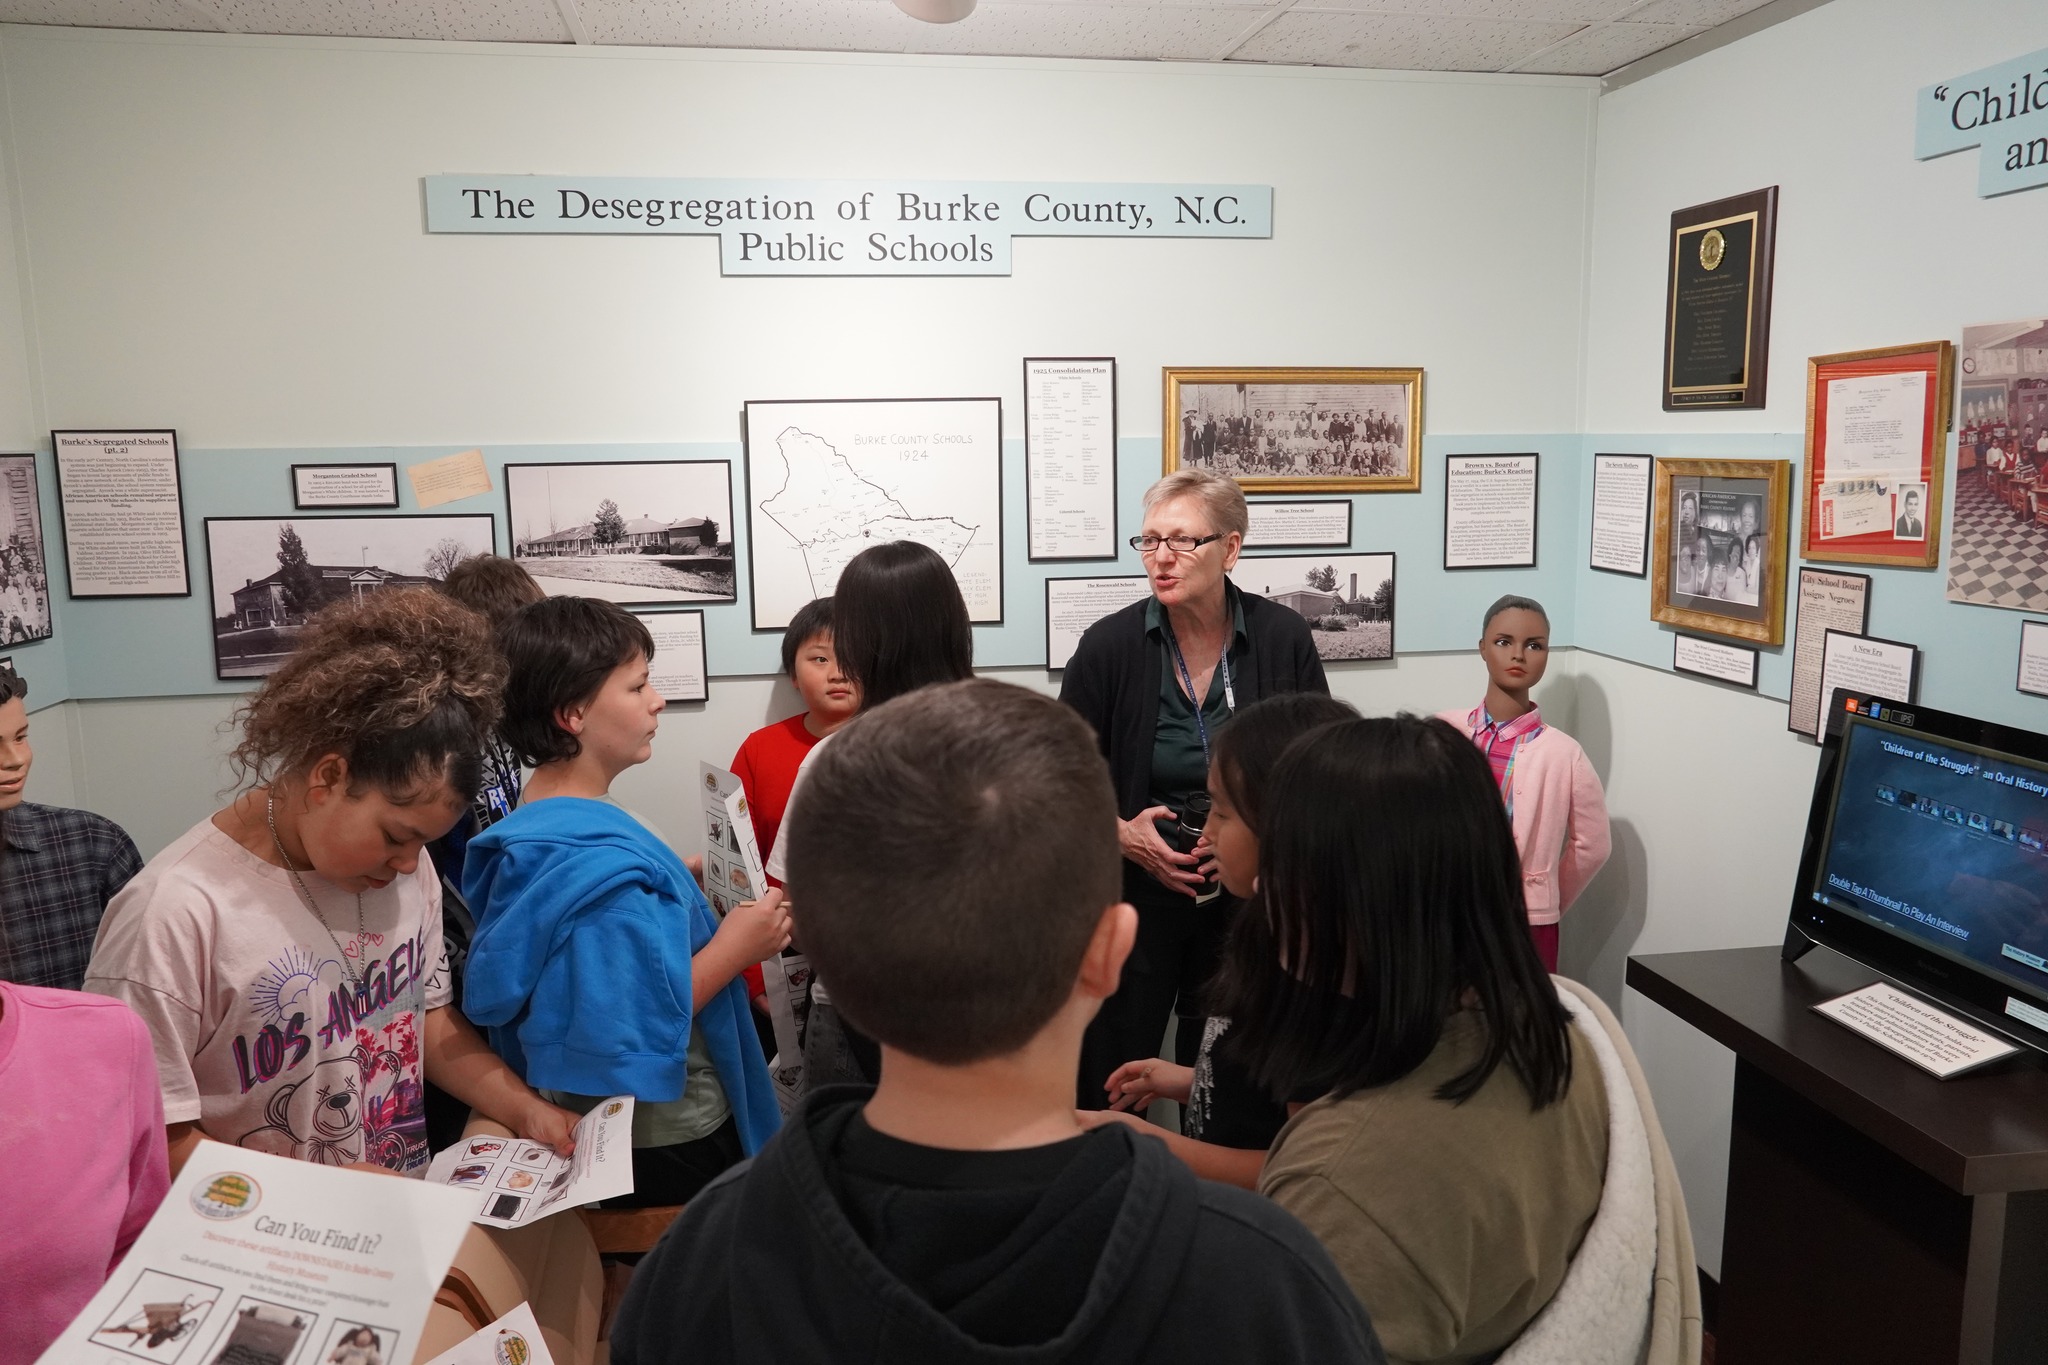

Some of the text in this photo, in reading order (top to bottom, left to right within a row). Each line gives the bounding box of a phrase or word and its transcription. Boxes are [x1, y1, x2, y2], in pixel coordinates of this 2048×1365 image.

[463, 189, 1247, 228] The Desegregation of Burke County, N.C.
[740, 234, 994, 264] Public Schools
[61, 438, 169, 447] Burke's Segregated Schools
[854, 433, 973, 445] BURKE COUNTY SCHOOLS
[104, 446, 129, 454] (pt. 2)
[899, 450, 929, 461] 1924
[1802, 574, 1864, 592] City School Board
[1801, 588, 1856, 605] Assigns Negroes
[1857, 645, 1870, 654] New
[1871, 648, 1883, 656] Era
[1880, 740, 2048, 797] "Children of the Struggle" an Oral History
[1829, 873, 1969, 938] Double Tap A Thumbnail To Play An Interview
[1921, 1011, 1931, 1019] of
[1929, 1015, 1944, 1026] the
[232, 1011, 311, 1094] LOS
[406, 1137, 428, 1154] TRUST
[254, 1215, 382, 1255] Can You Find It?
